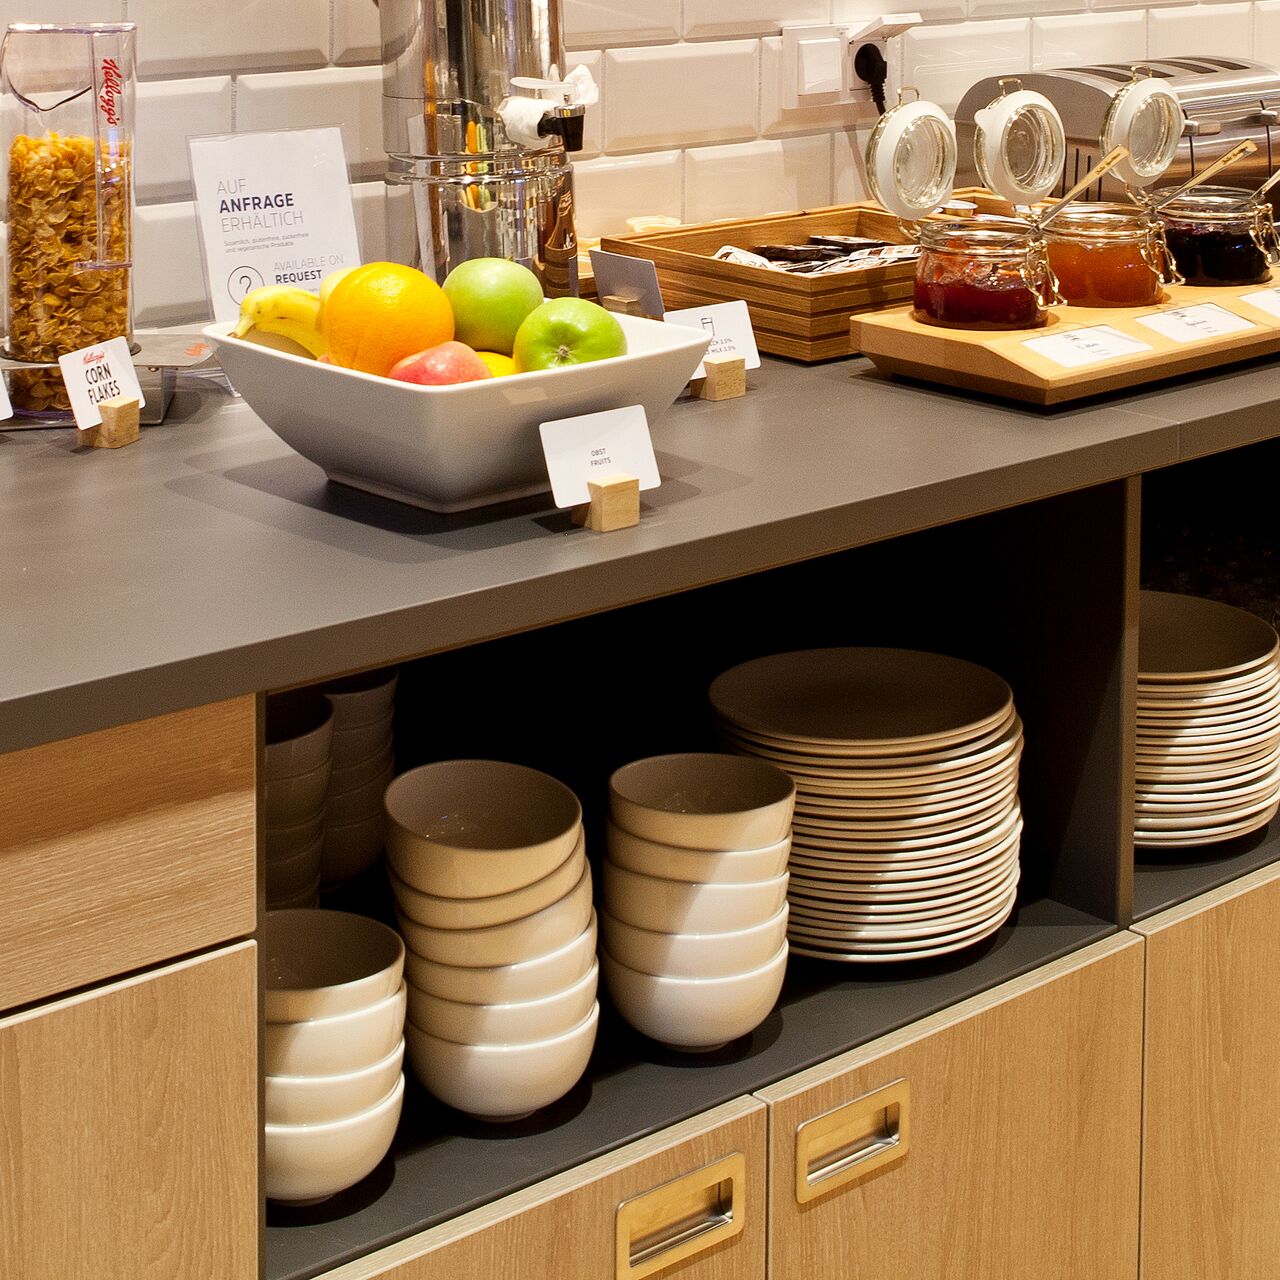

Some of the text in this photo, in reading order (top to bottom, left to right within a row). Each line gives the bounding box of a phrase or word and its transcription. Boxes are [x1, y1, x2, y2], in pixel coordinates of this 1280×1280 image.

[100, 58, 122, 126] Kellogg's
[217, 178, 246, 195] AUF
[220, 193, 294, 213] ANFRAGE
[221, 210, 304, 233] ERHÄLTICH
[274, 255, 344, 271] AVAILABLE ON
[276, 269, 322, 284] REQUEST
[85, 362, 112, 385] CORN
[88, 380, 121, 405] FLAKES
